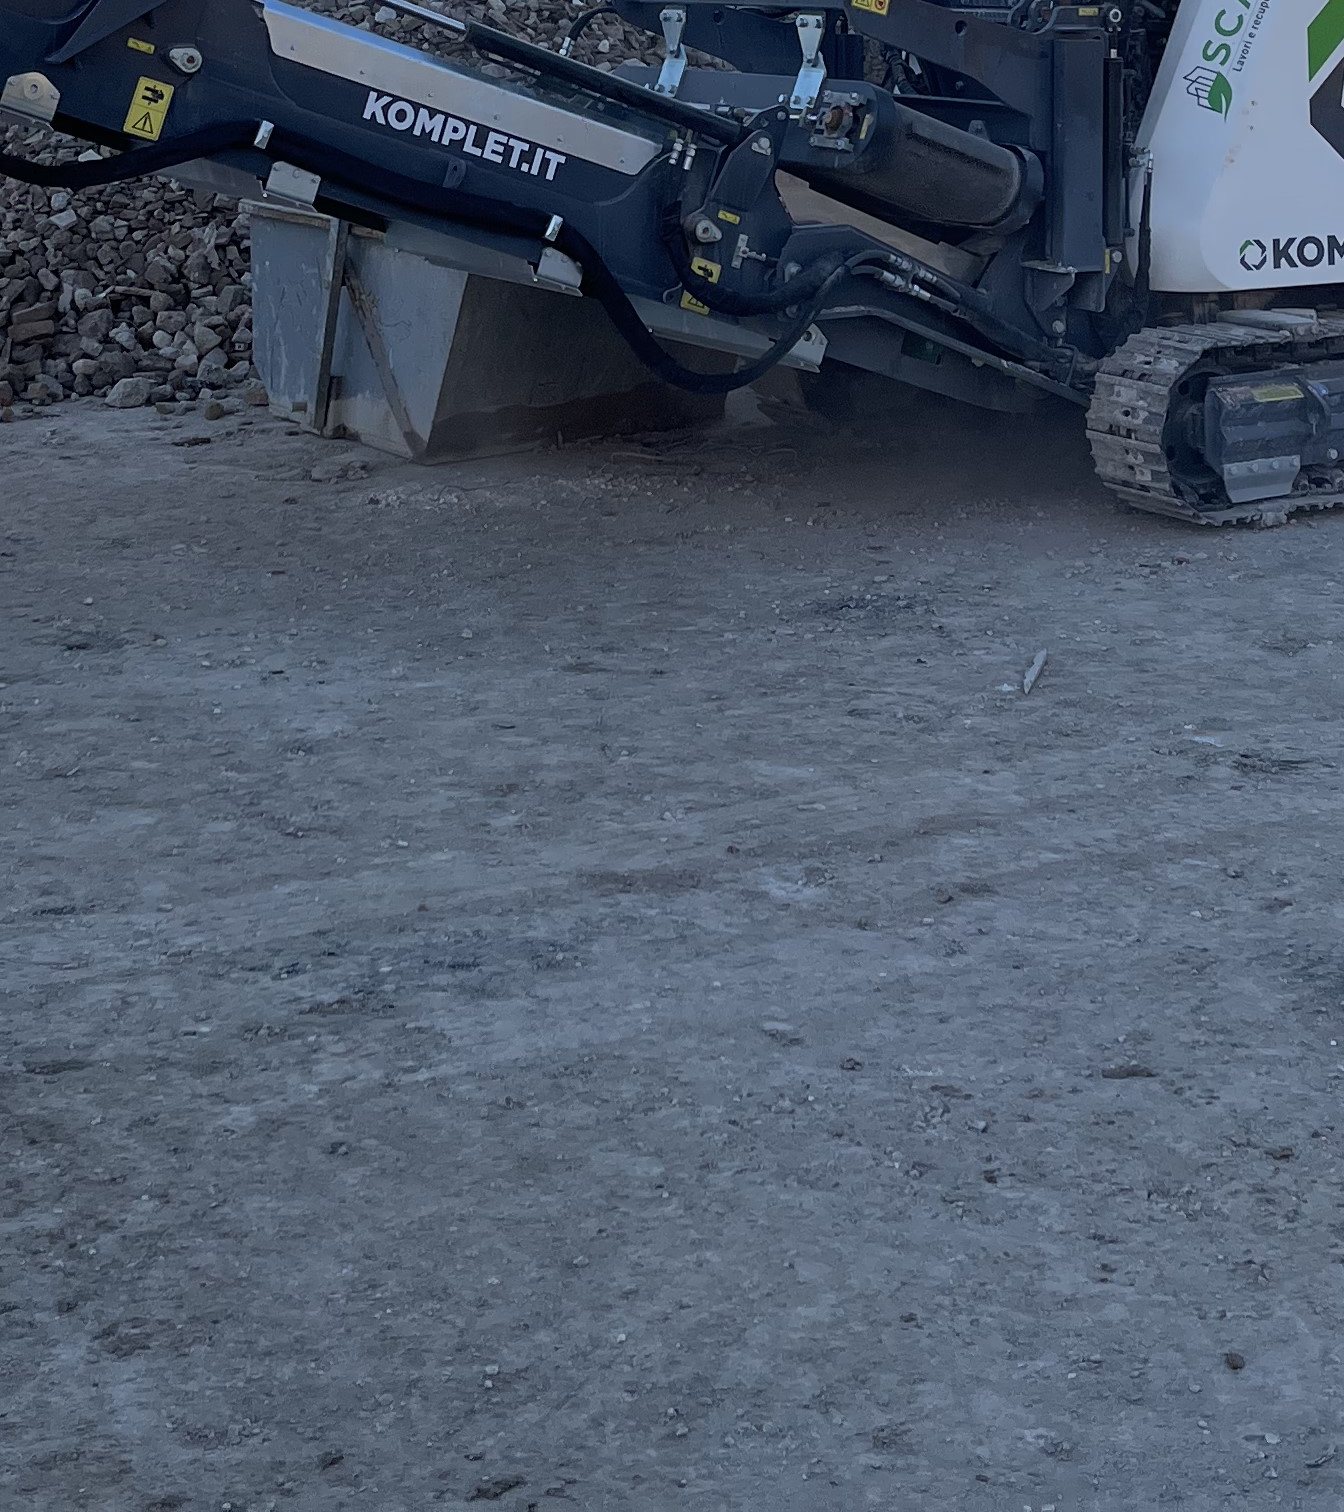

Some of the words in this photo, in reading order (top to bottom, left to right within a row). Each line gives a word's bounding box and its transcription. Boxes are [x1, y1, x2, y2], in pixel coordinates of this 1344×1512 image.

[1232, 40, 1253, 72] Lavori
[1248, 31, 1257, 39] e
[362, 90, 567, 182] KOMPLET.IT
